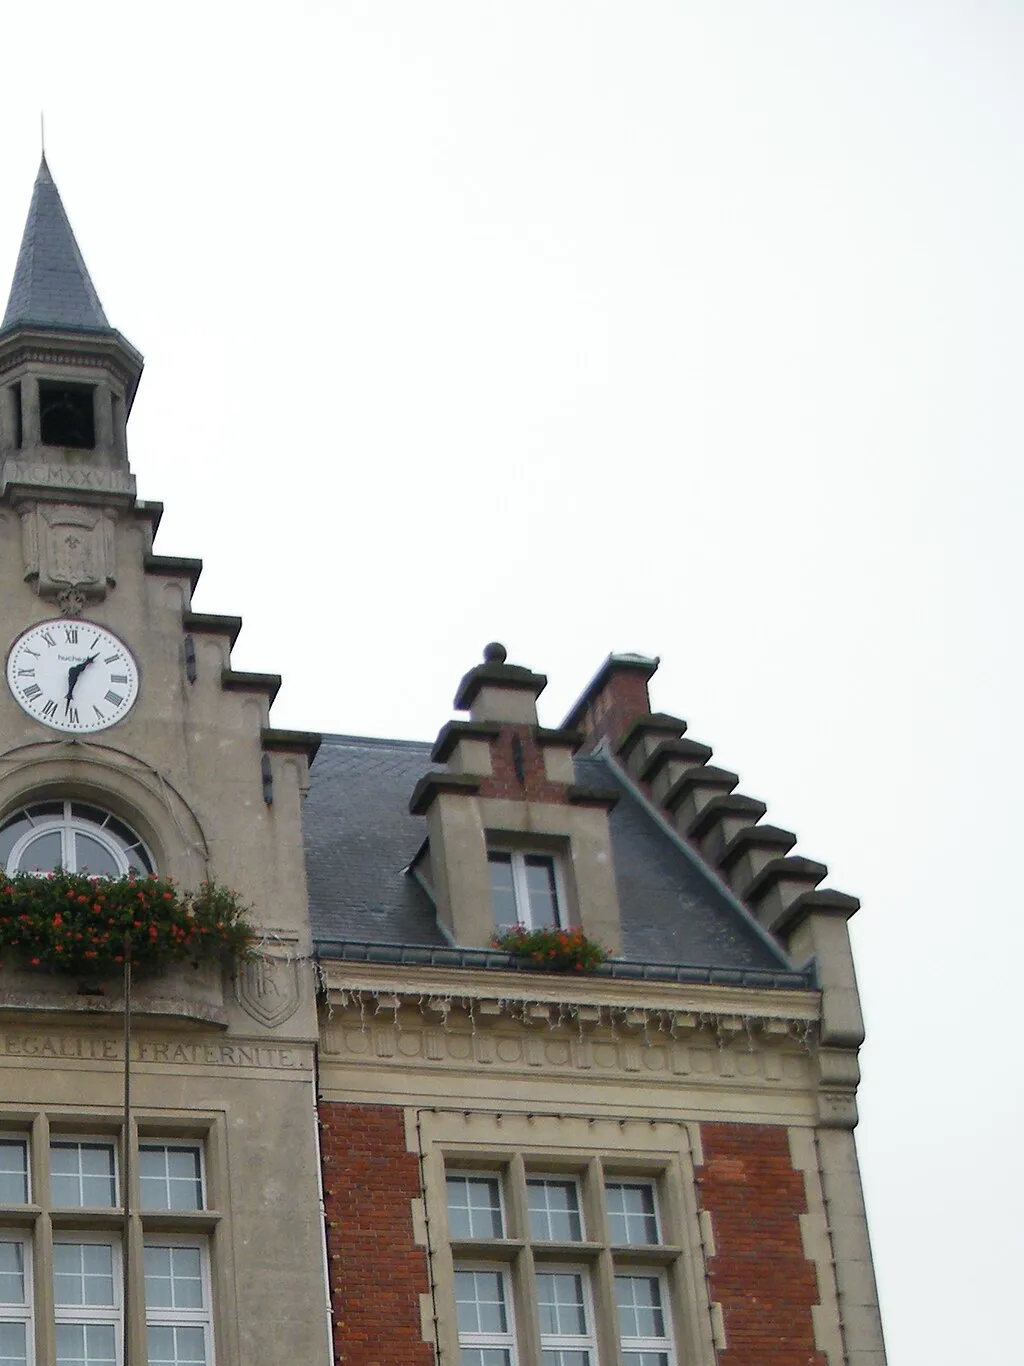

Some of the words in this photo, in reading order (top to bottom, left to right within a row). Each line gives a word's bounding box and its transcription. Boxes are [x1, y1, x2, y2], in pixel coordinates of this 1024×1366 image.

[41, 632, 56, 648] XI
[65, 629, 78, 644] XII
[24, 647, 41, 660] X
[104, 654, 120, 665] II
[18, 668, 35, 678] IX
[111, 674, 128, 684] III
[23, 683, 43, 702] VIII
[42, 699, 59, 718] VII
[69, 707, 80, 724] VI
[93, 705, 105, 721] V
[4, 1033, 118, 1058] EGALITE
